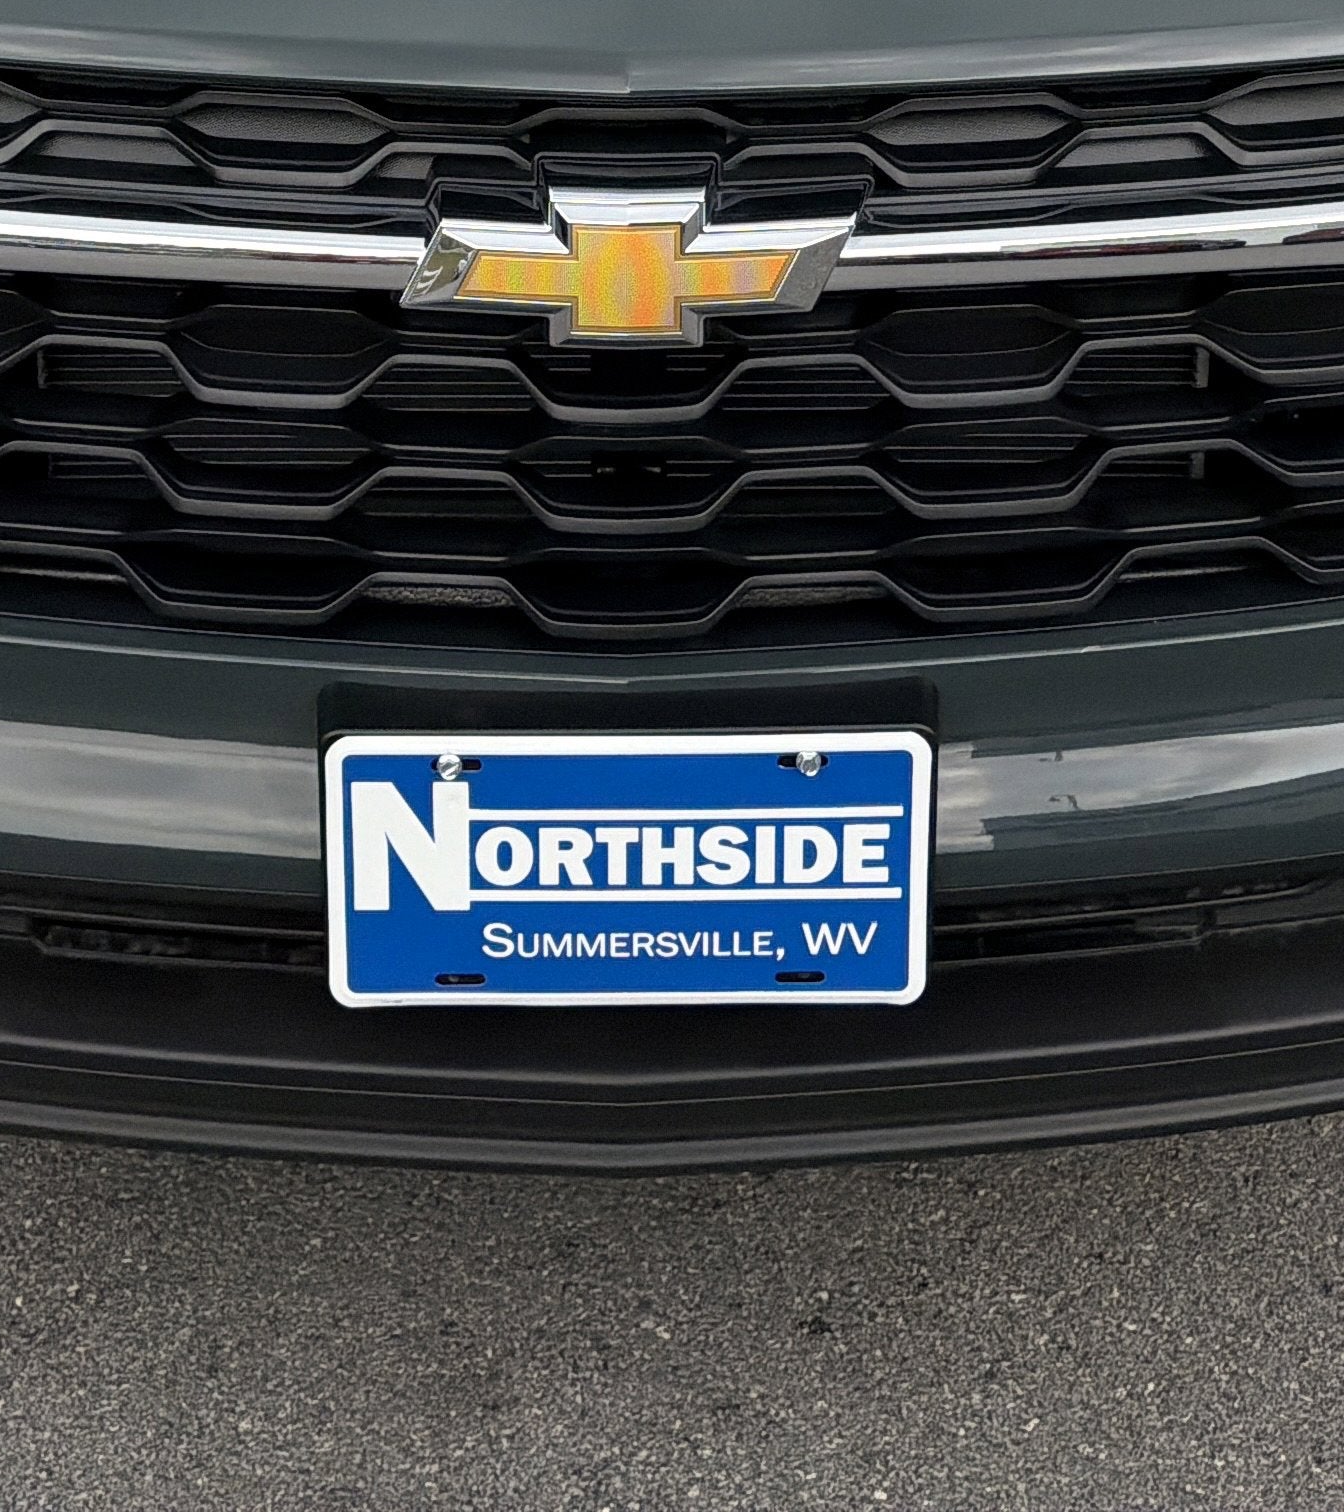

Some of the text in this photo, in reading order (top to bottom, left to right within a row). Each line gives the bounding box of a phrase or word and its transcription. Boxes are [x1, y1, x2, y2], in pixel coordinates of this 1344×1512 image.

[350, 780, 892, 912] NORTHSIDE
[481, 920, 879, 963] SUMMERSVILLE, WV
